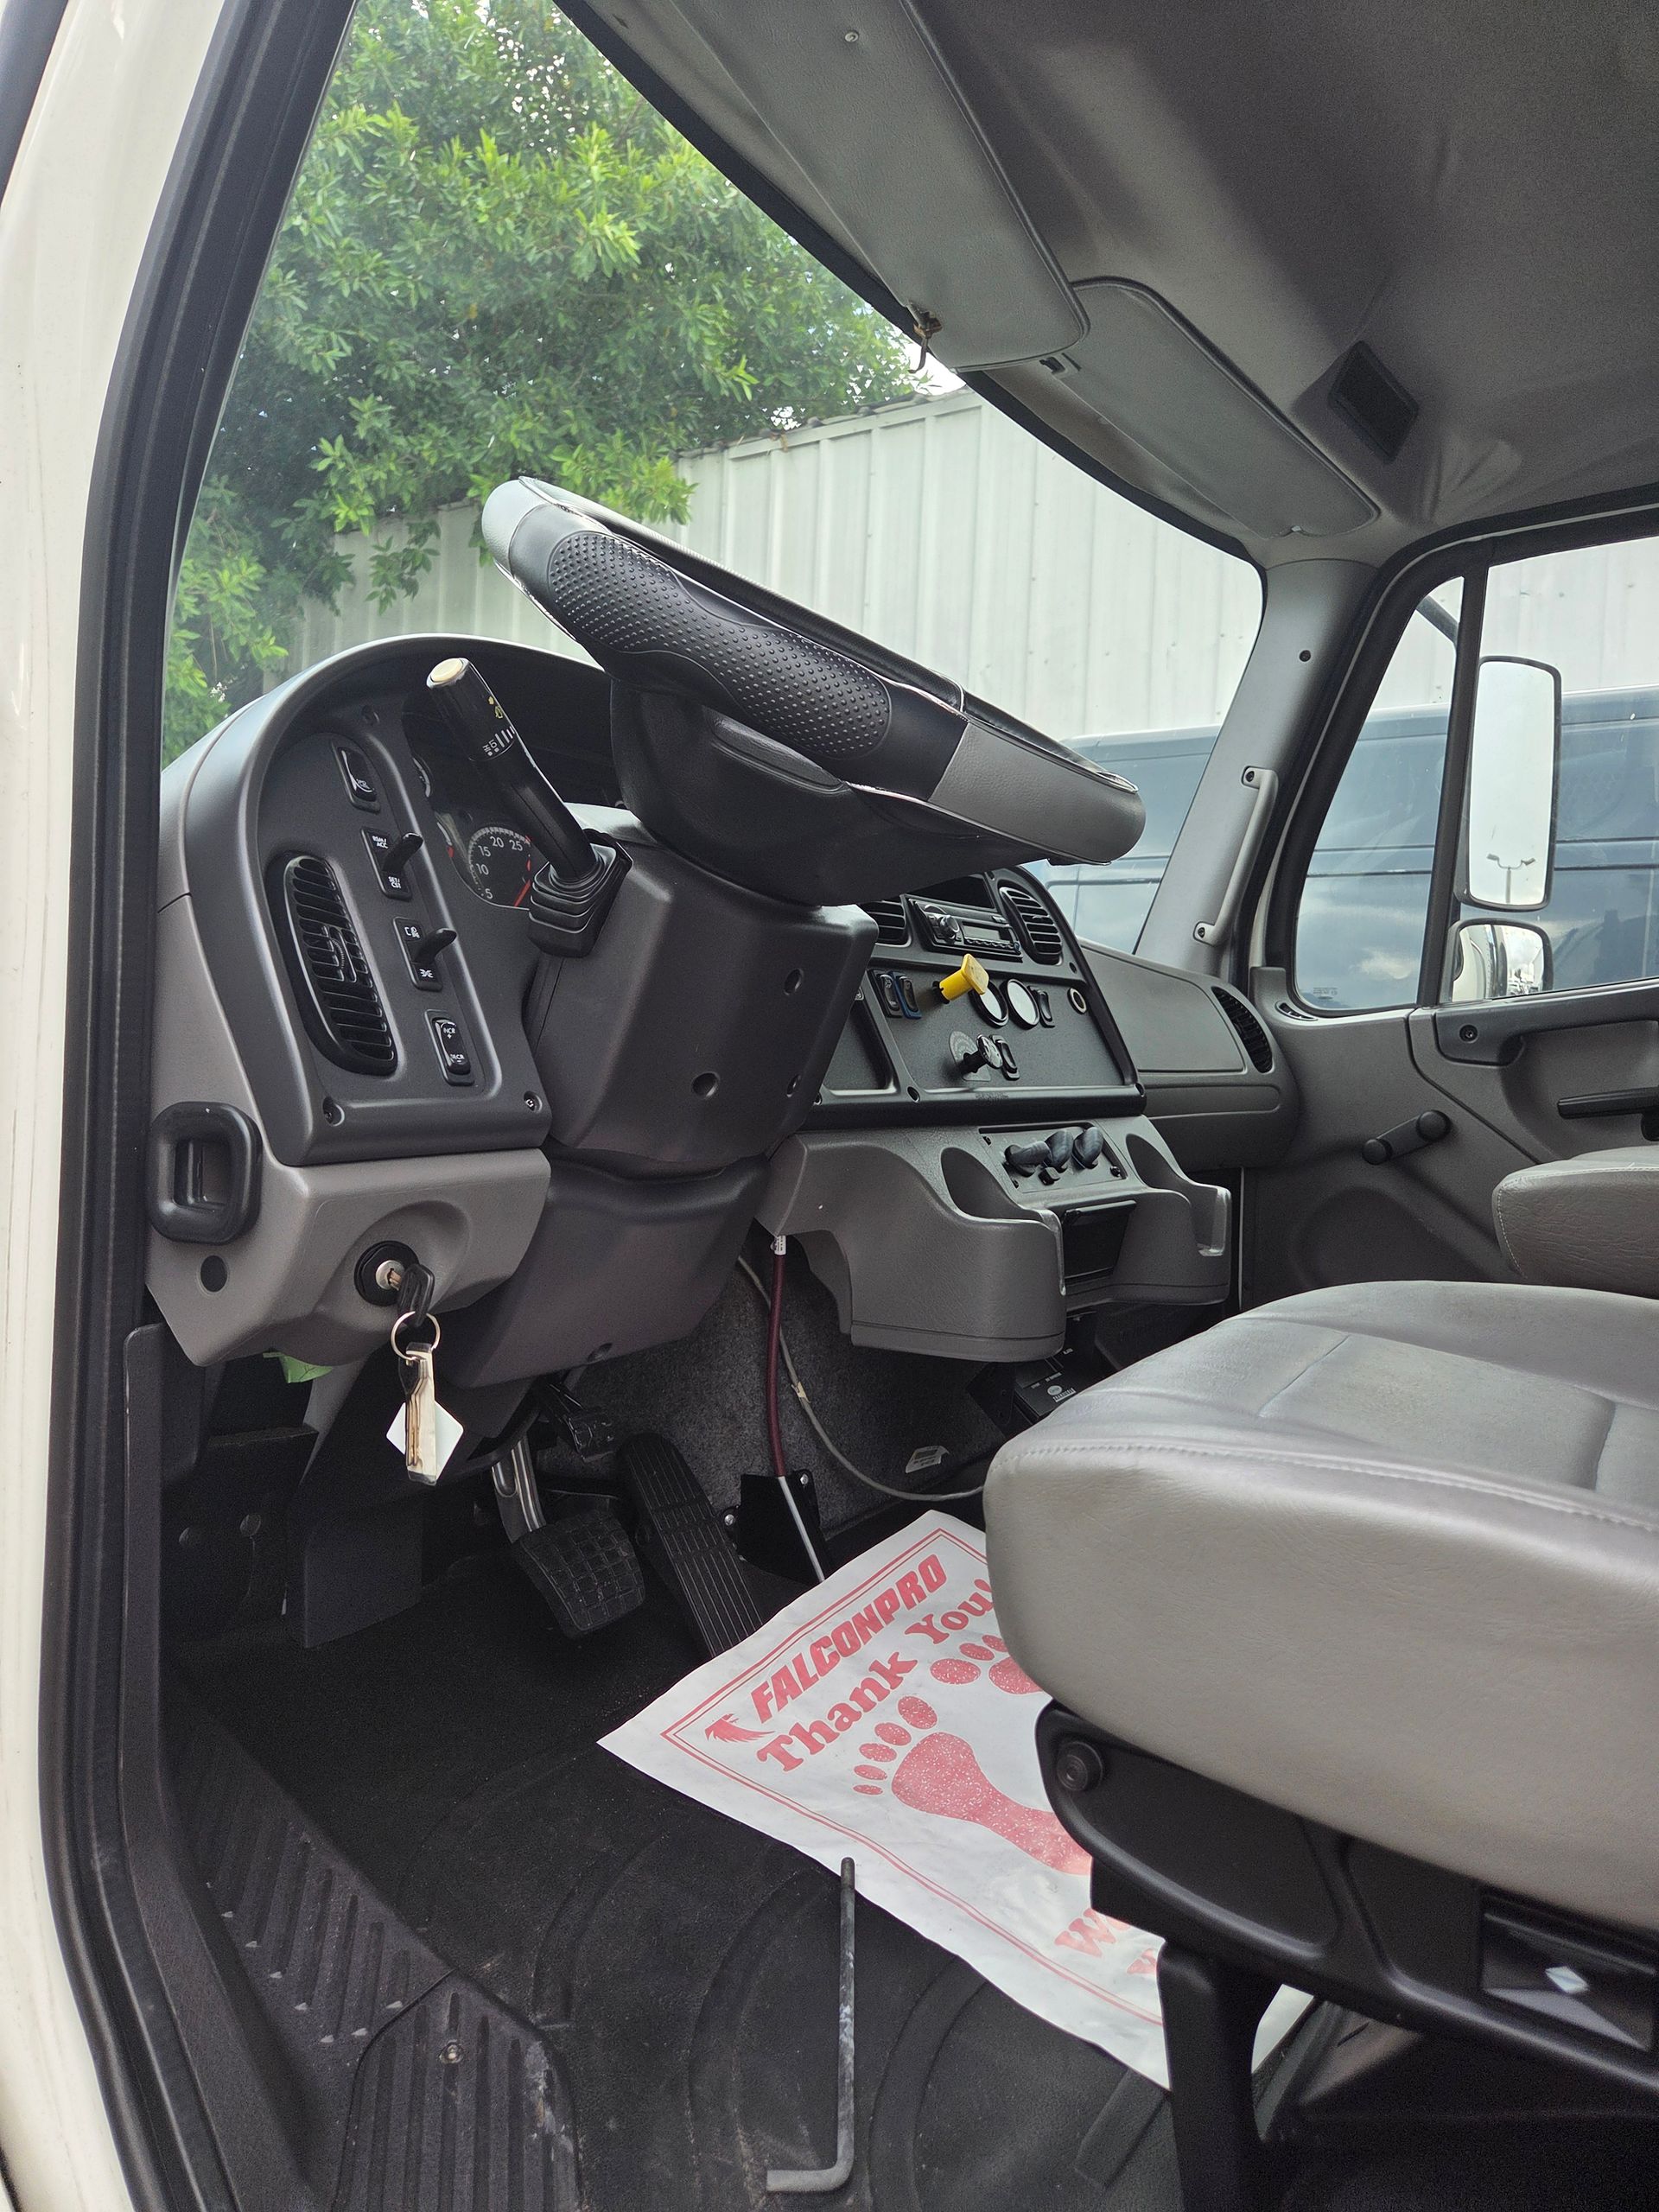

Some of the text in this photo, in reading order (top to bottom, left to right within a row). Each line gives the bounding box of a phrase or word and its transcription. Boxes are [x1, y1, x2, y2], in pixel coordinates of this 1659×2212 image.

[489, 836, 505, 848] 20
[508, 839, 524, 851] 25
[478, 845, 492, 857] 15
[476, 863, 489, 875] 10
[485, 888, 493, 899] 5
[751, 1554, 947, 1724] FALCONPRO
[756, 1651, 918, 1772] Thank
